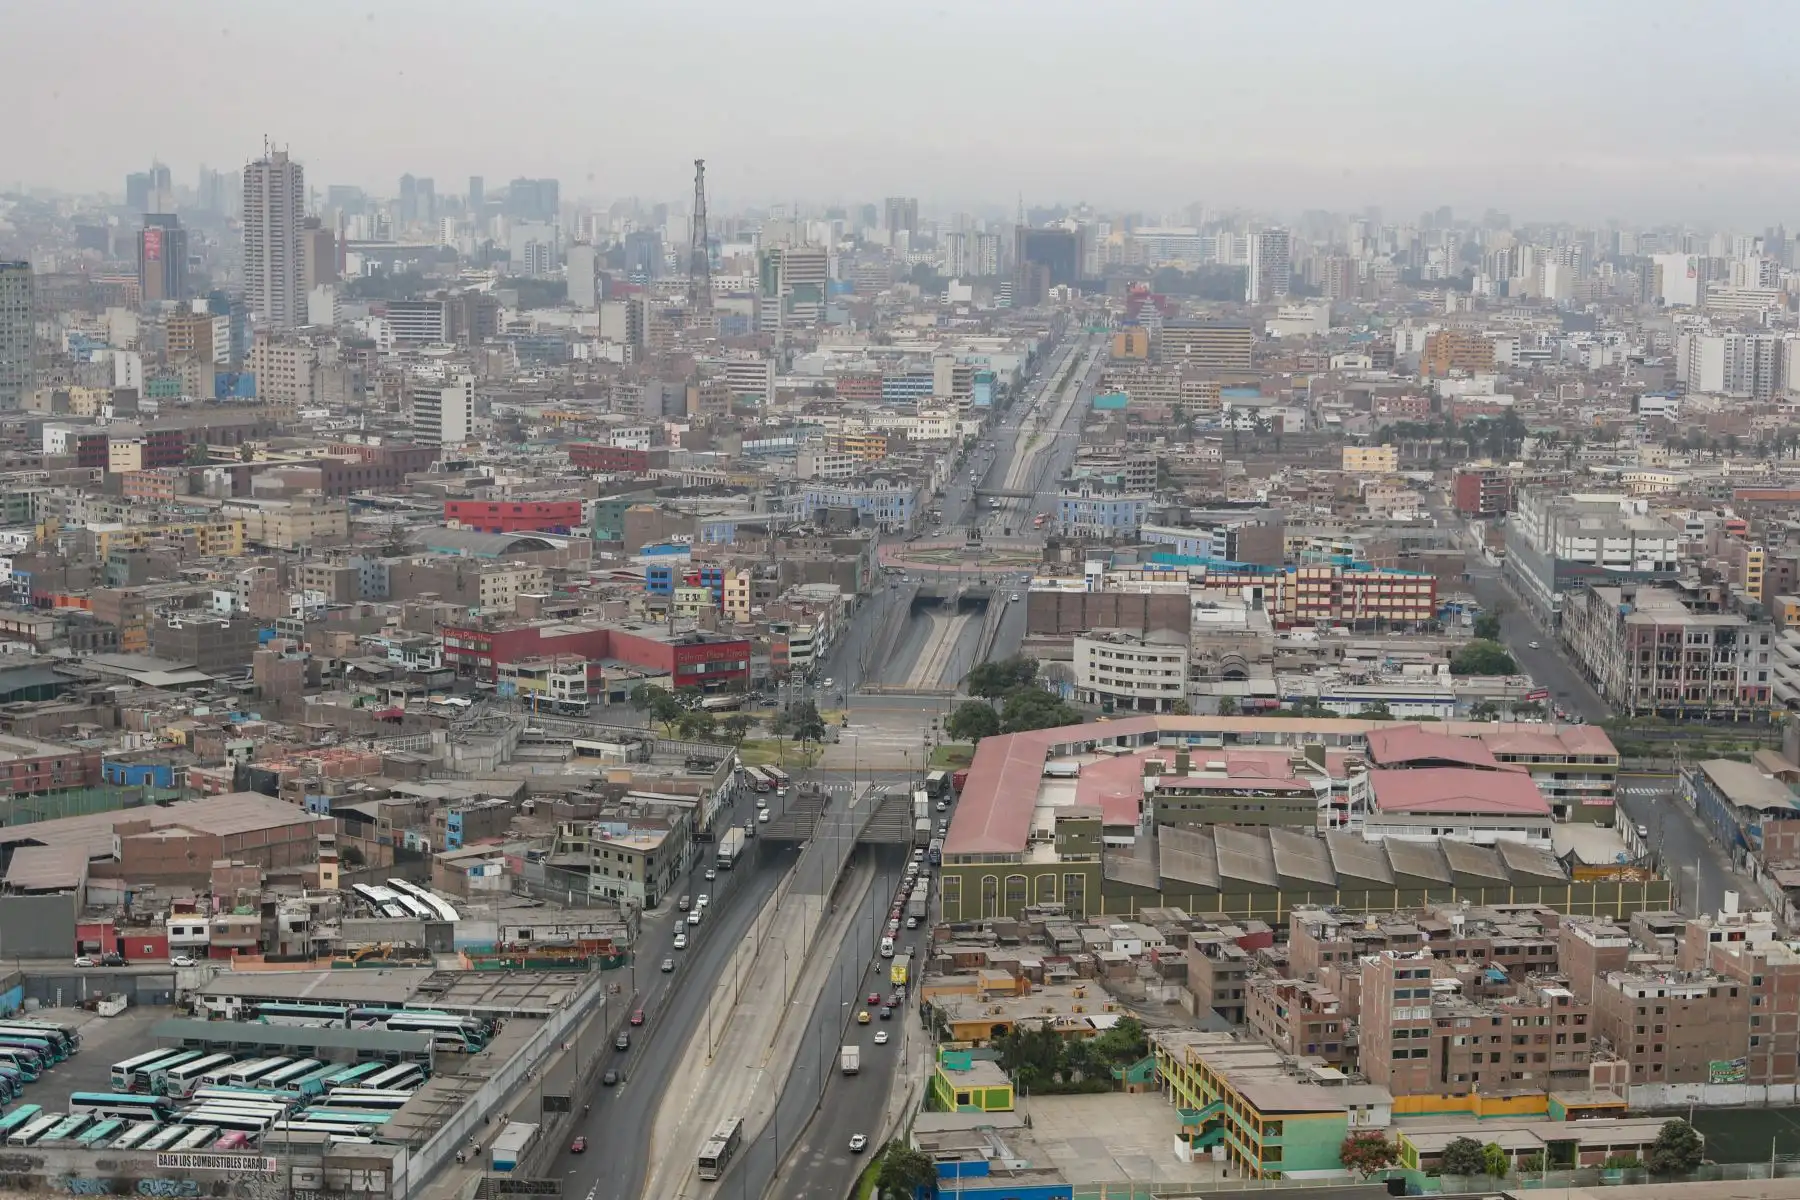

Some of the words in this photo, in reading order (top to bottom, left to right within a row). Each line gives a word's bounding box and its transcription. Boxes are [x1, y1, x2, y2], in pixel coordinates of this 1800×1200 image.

[158, 1154, 178, 1167] BAJEN
[179, 1154, 191, 1167] LOS
[192, 1155, 242, 1169] COMBUSTIBLES
